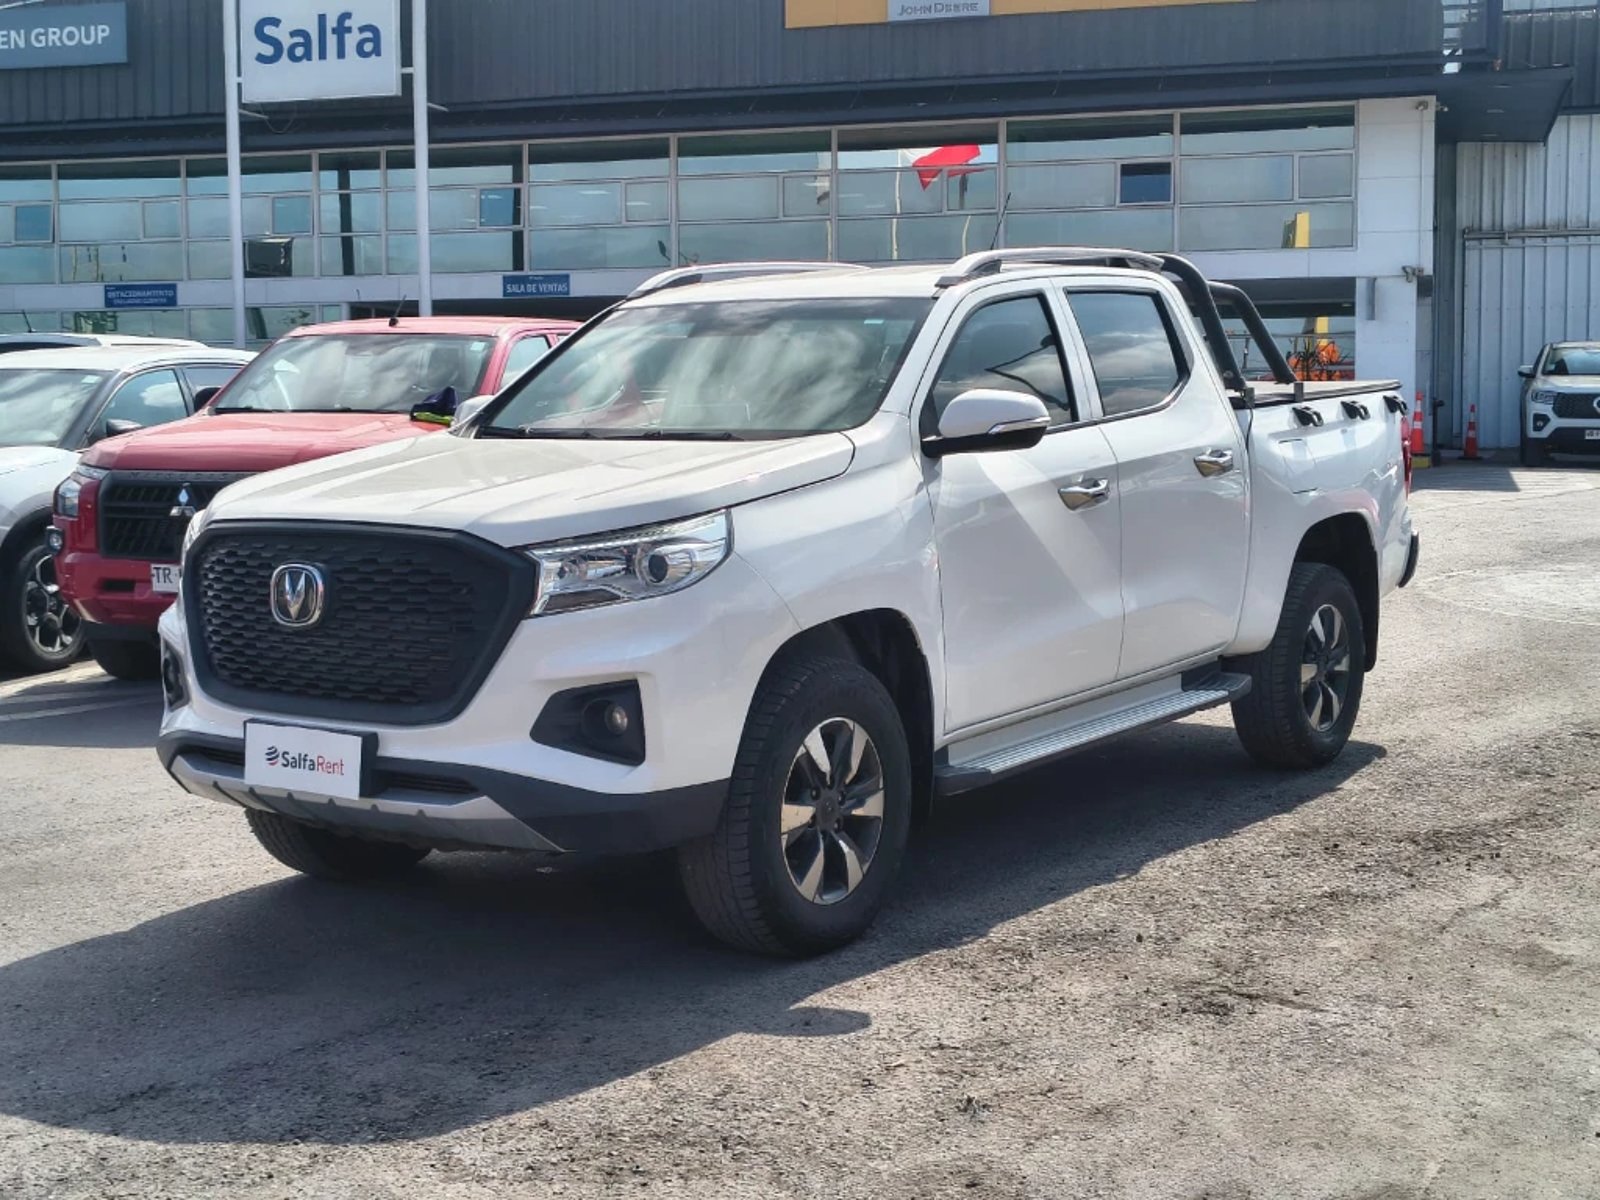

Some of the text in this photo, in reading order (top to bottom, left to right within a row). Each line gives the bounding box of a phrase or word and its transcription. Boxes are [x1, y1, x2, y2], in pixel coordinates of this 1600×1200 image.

[899, 4, 932, 16] JOHN
[30, 25, 110, 47] GROUP
[254, 12, 383, 65] Salfa
[506, 282, 568, 293] SALA DE VENTAS
